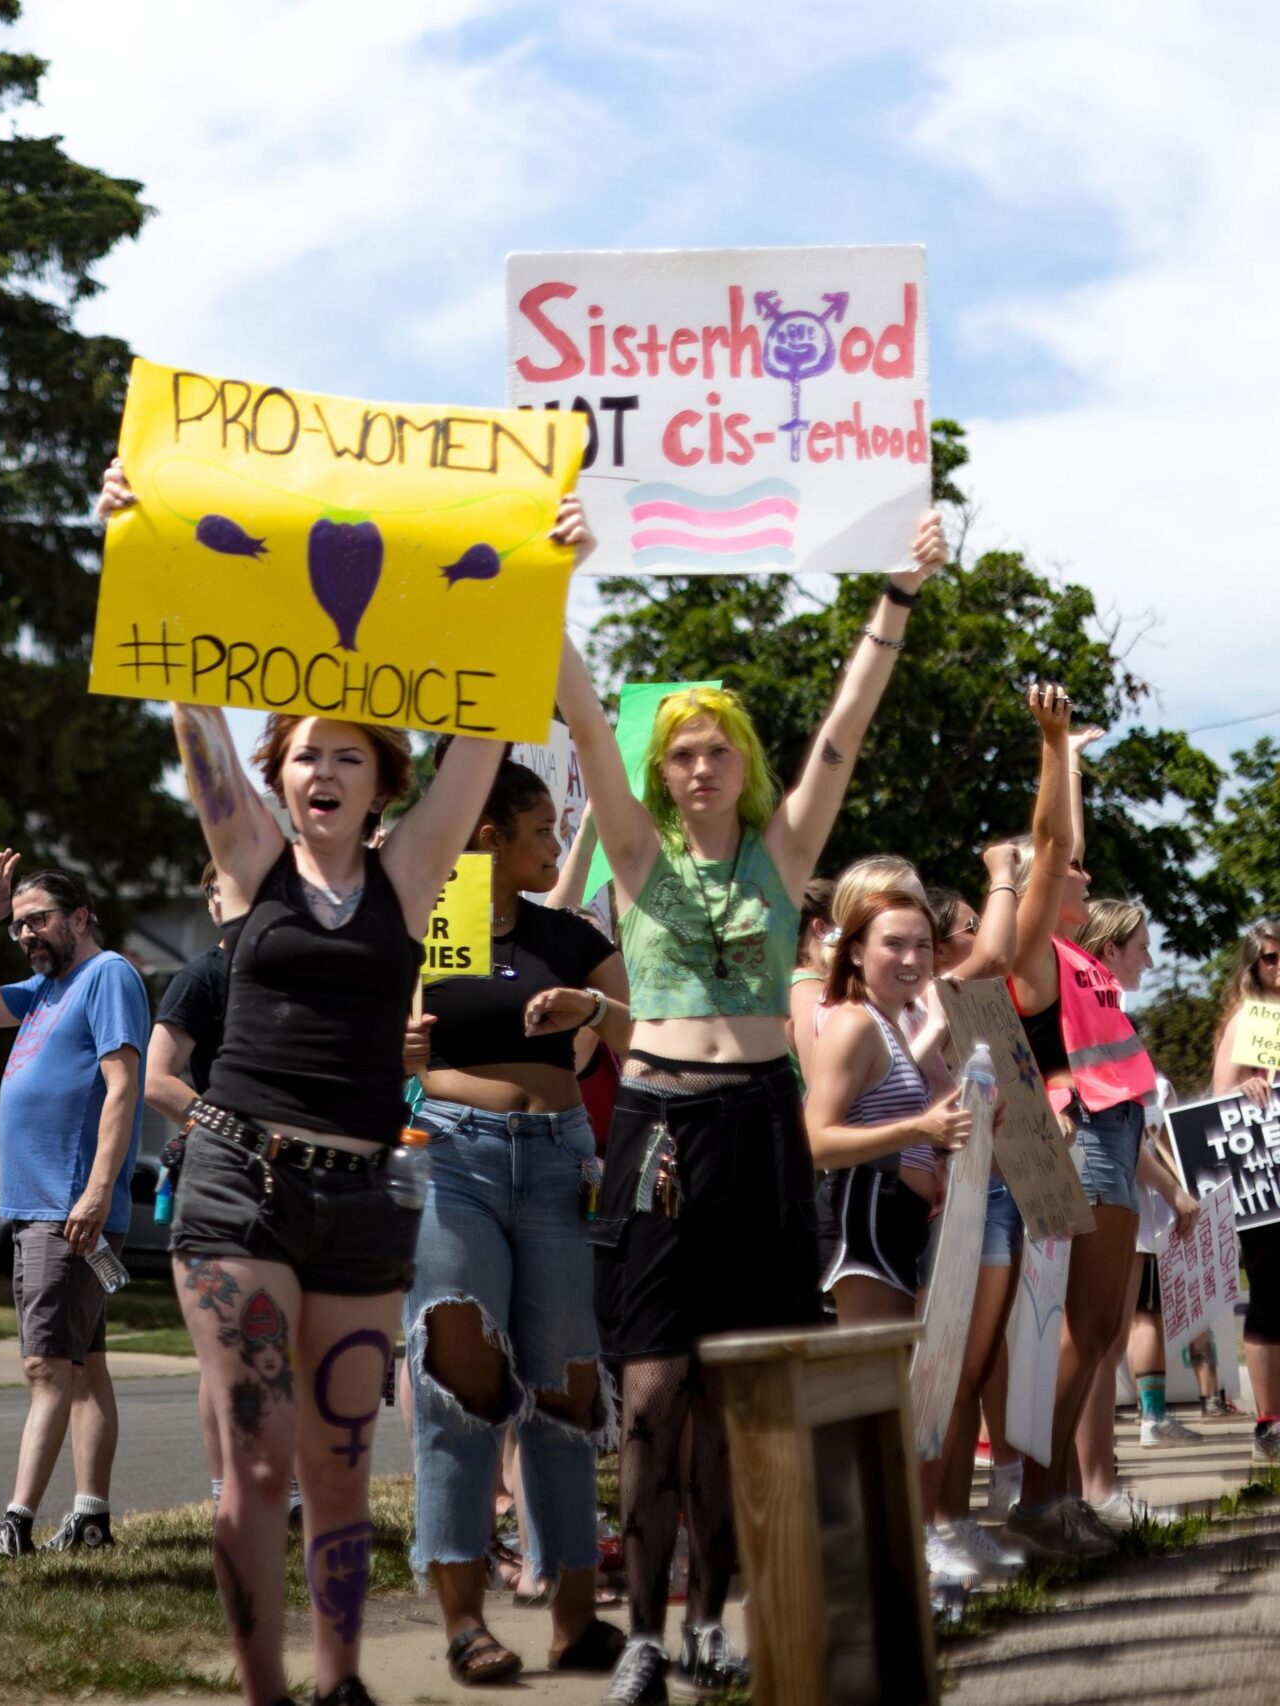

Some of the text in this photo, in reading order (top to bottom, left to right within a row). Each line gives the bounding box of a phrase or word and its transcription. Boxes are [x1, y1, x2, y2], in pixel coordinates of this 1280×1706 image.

[174, 372, 556, 475] PRO-WOMEN
[518, 394, 640, 470] OT
[117, 621, 497, 733] #PROCHOICE
[1207, 1131, 1255, 1160] TO
[1218, 1212, 1236, 1277] WISH
